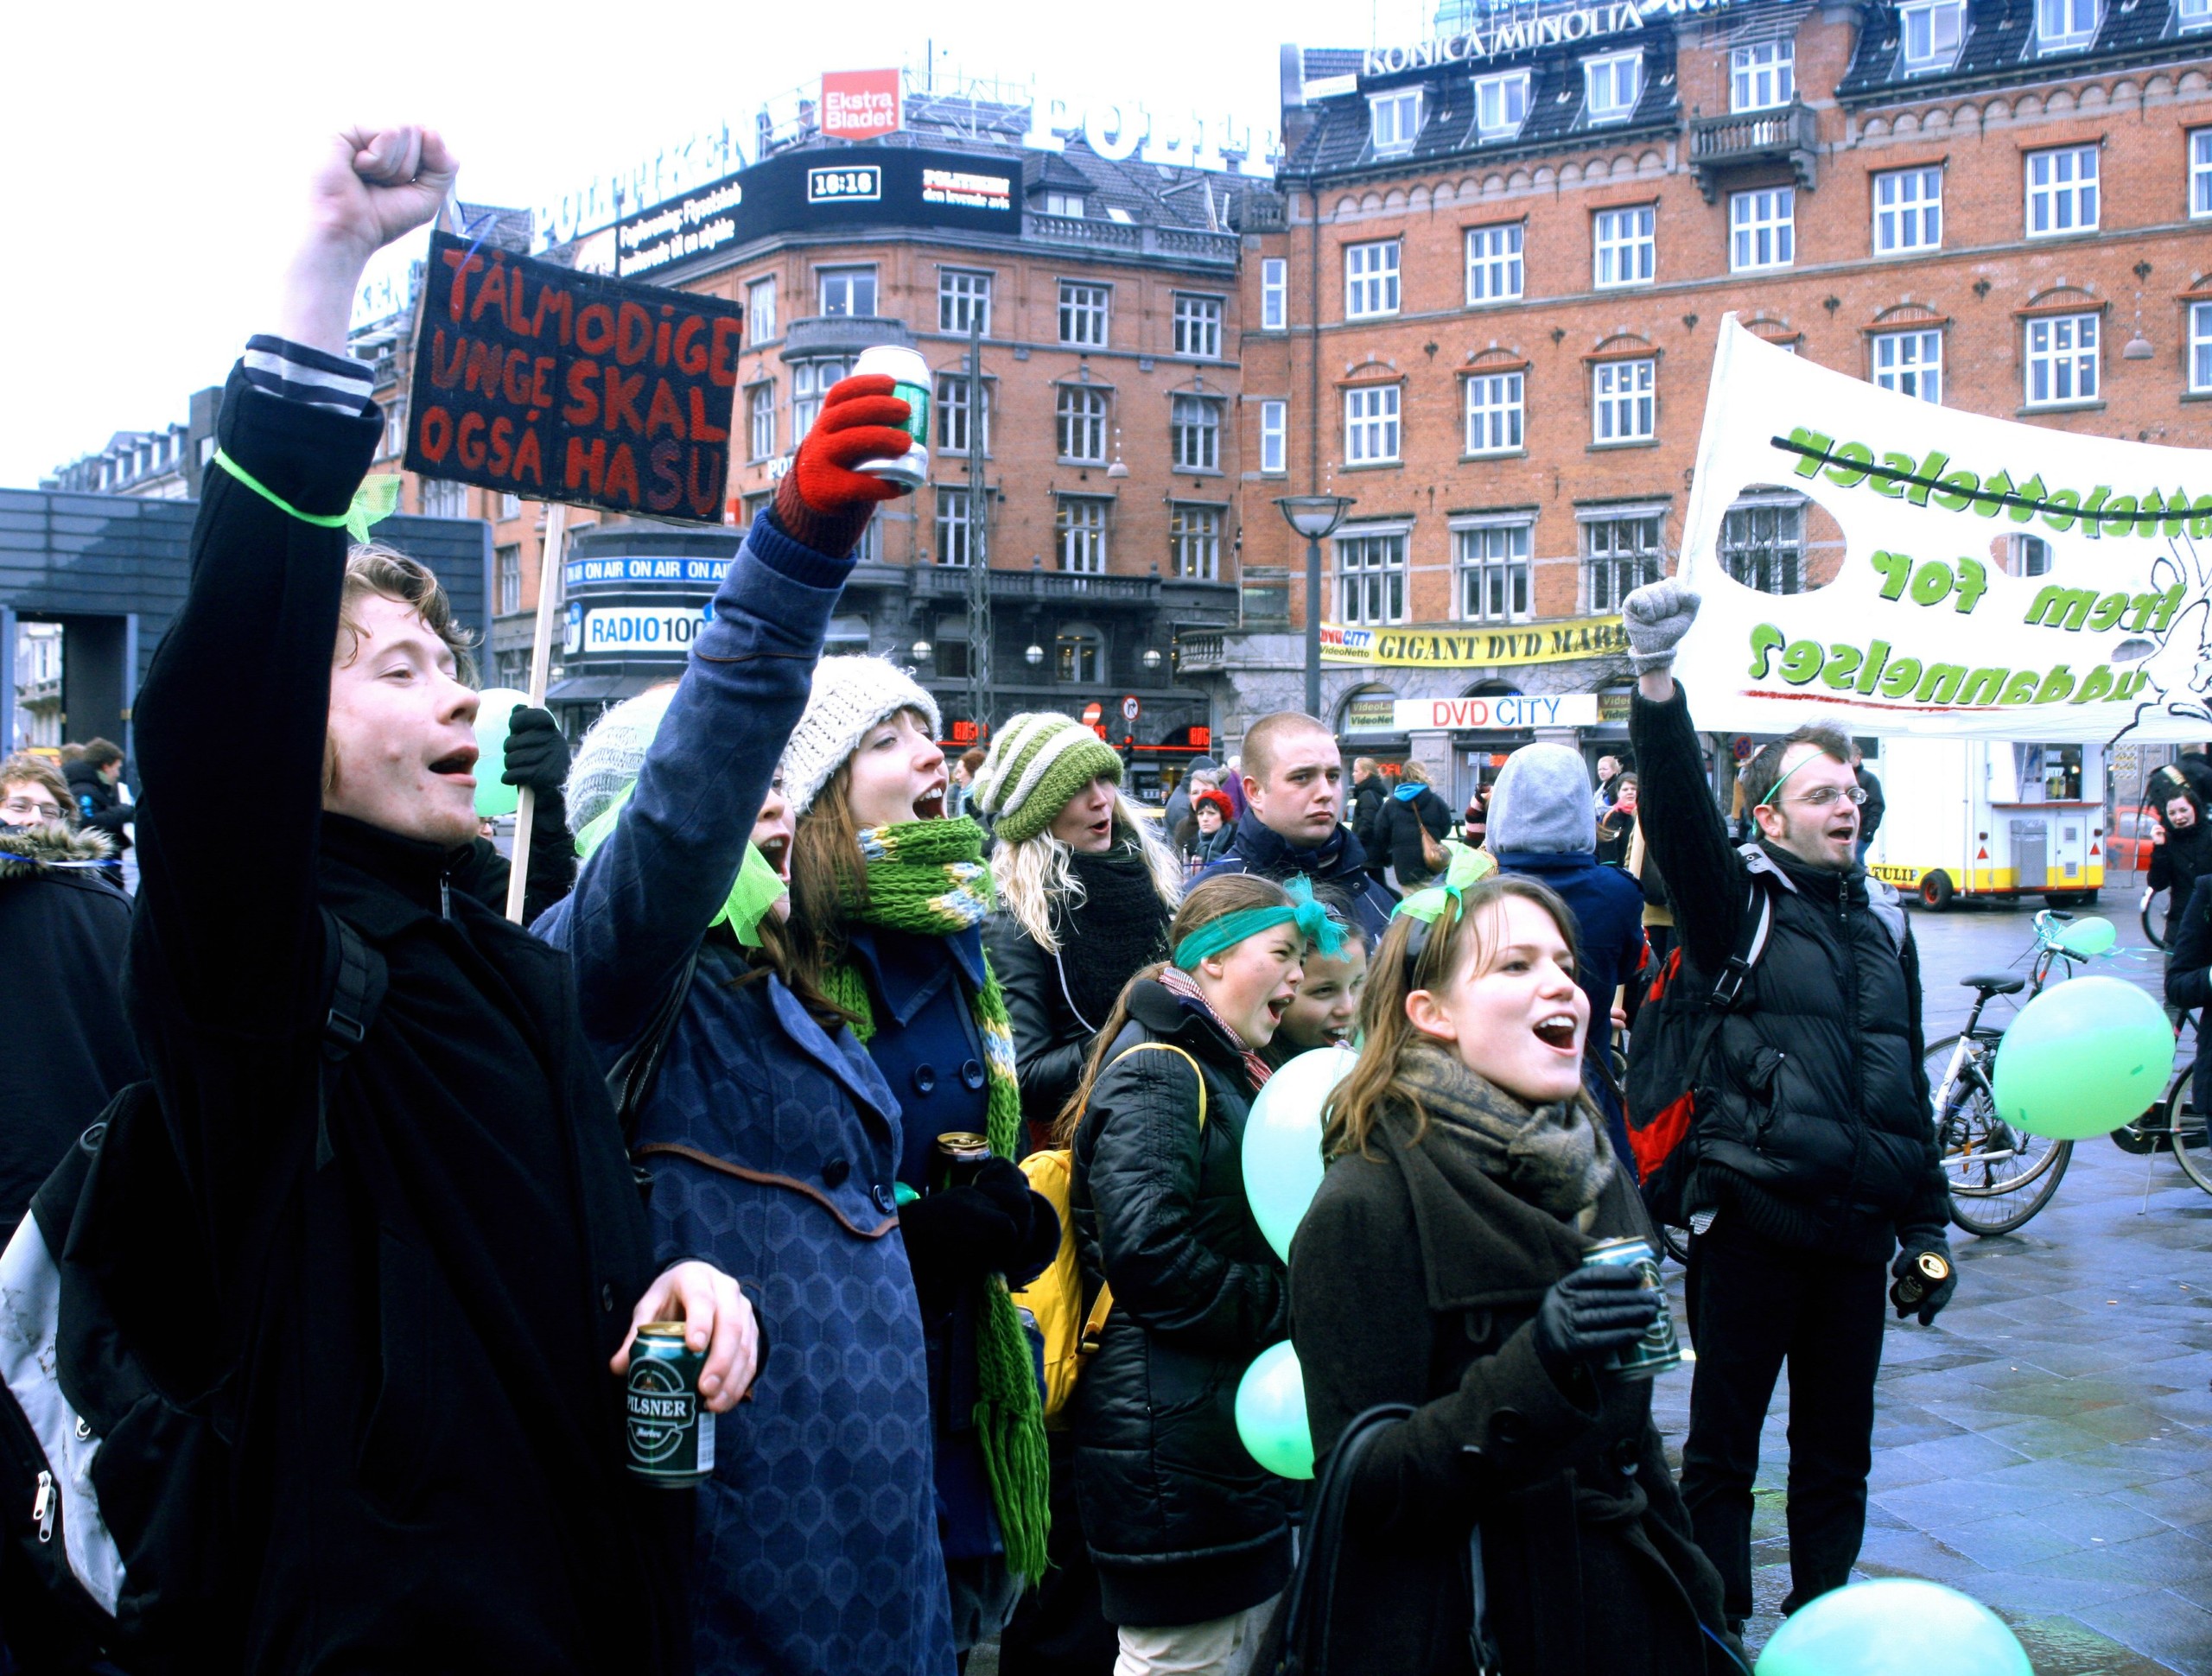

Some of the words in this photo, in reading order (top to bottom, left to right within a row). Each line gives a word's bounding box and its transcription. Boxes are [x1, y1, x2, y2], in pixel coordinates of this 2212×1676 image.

[1363, 28, 1486, 76] KONICA
[1495, 2, 1643, 53] MINOLTA
[826, 92, 893, 111] Ekstra
[826, 109, 893, 130] Bladet
[431, 328, 556, 410] UNGE
[563, 359, 728, 442] SKAL
[566, 436, 640, 507] HA
[647, 439, 721, 515] SU
[585, 562, 602, 579] ON
[604, 562, 623, 577] AIR
[629, 560, 652, 577] ON
[654, 561, 681, 577] AIR
[688, 562, 709, 578] ON
[712, 562, 730, 578] AI
[1378, 636, 1479, 660] GIGANT
[1487, 633, 1542, 659] DVD
[1433, 700, 1489, 727] DVD
[1496, 697, 1560, 726] CITY
[1872, 867, 1918, 882] TULIP
